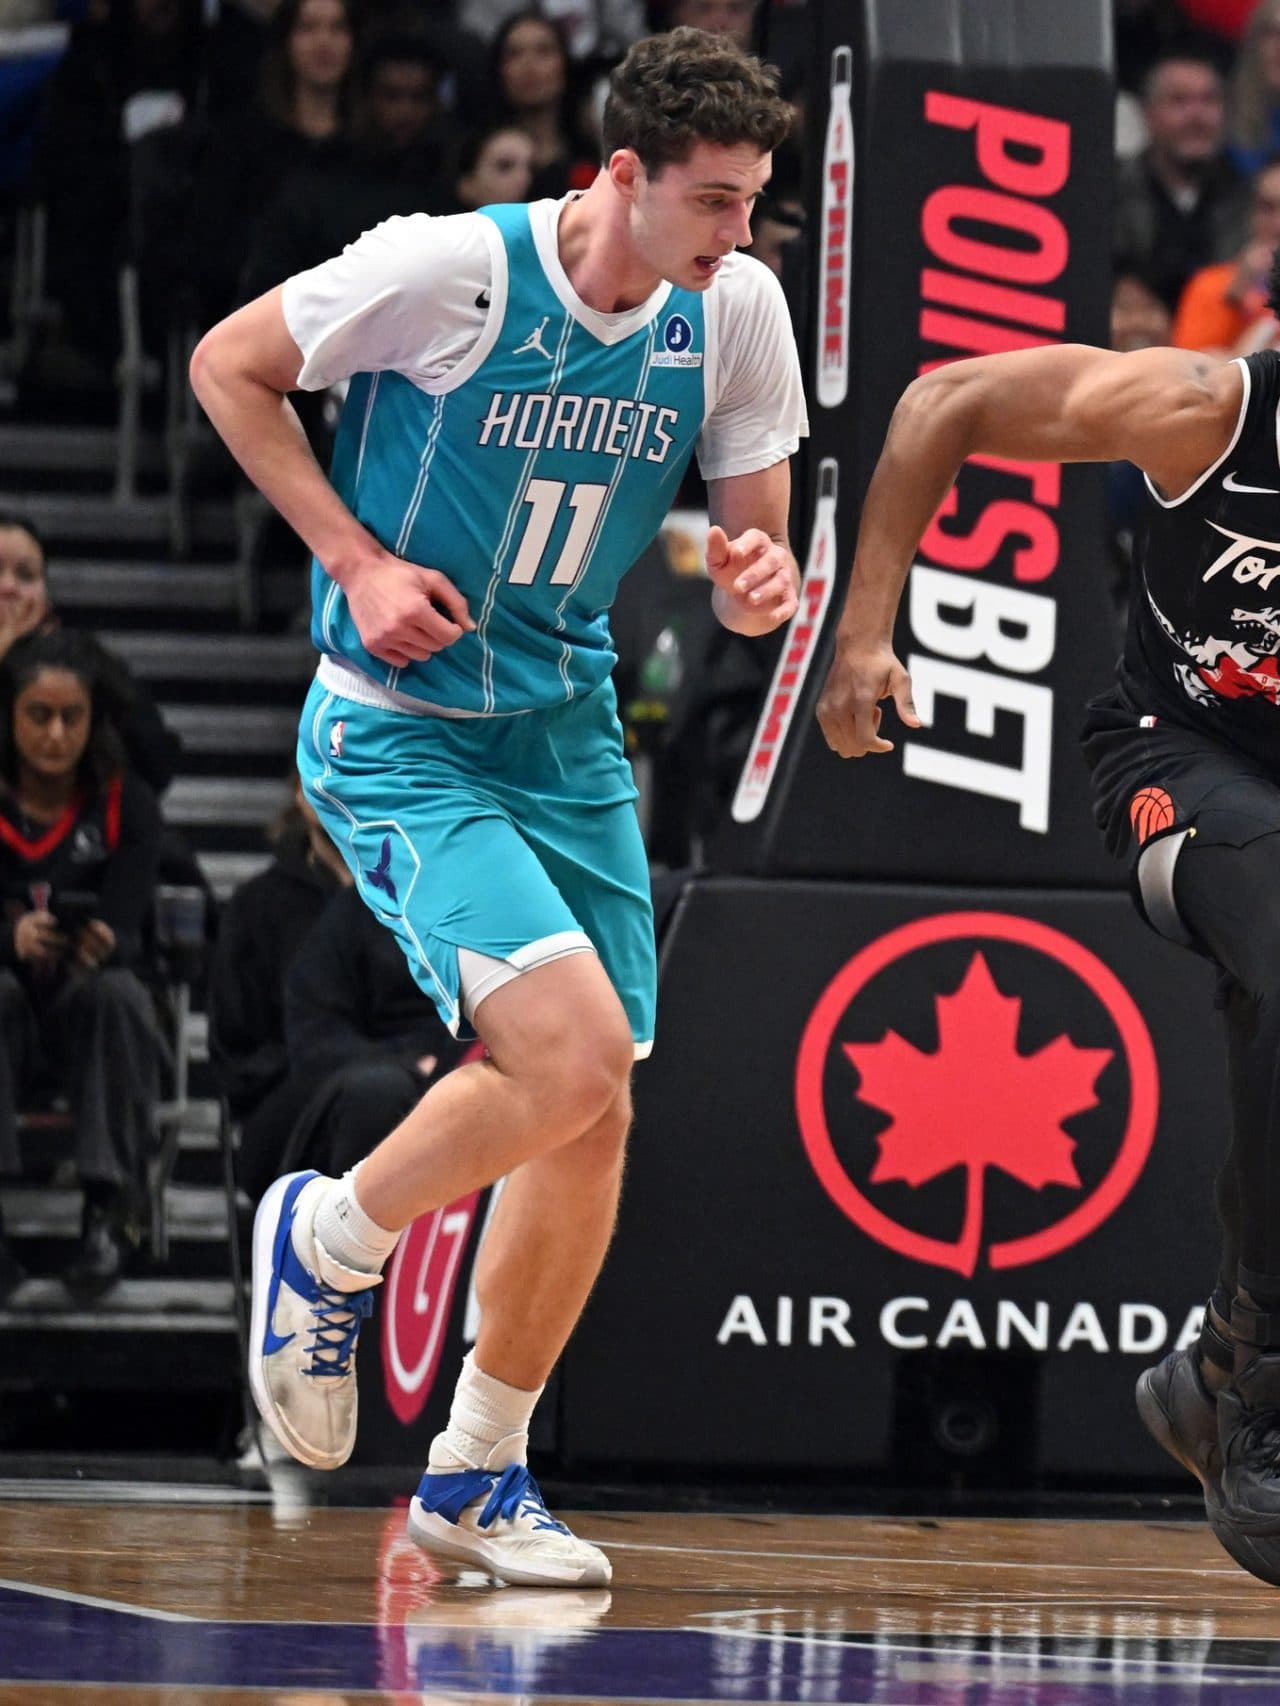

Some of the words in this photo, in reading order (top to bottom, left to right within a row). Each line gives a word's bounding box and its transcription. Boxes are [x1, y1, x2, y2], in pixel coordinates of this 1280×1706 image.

[823, 160, 848, 369] PRIME
[478, 392, 680, 464] HORNETS
[507, 478, 610, 586] 11
[747, 577, 826, 785] PRIME
[716, 1294, 857, 1347] AIR
